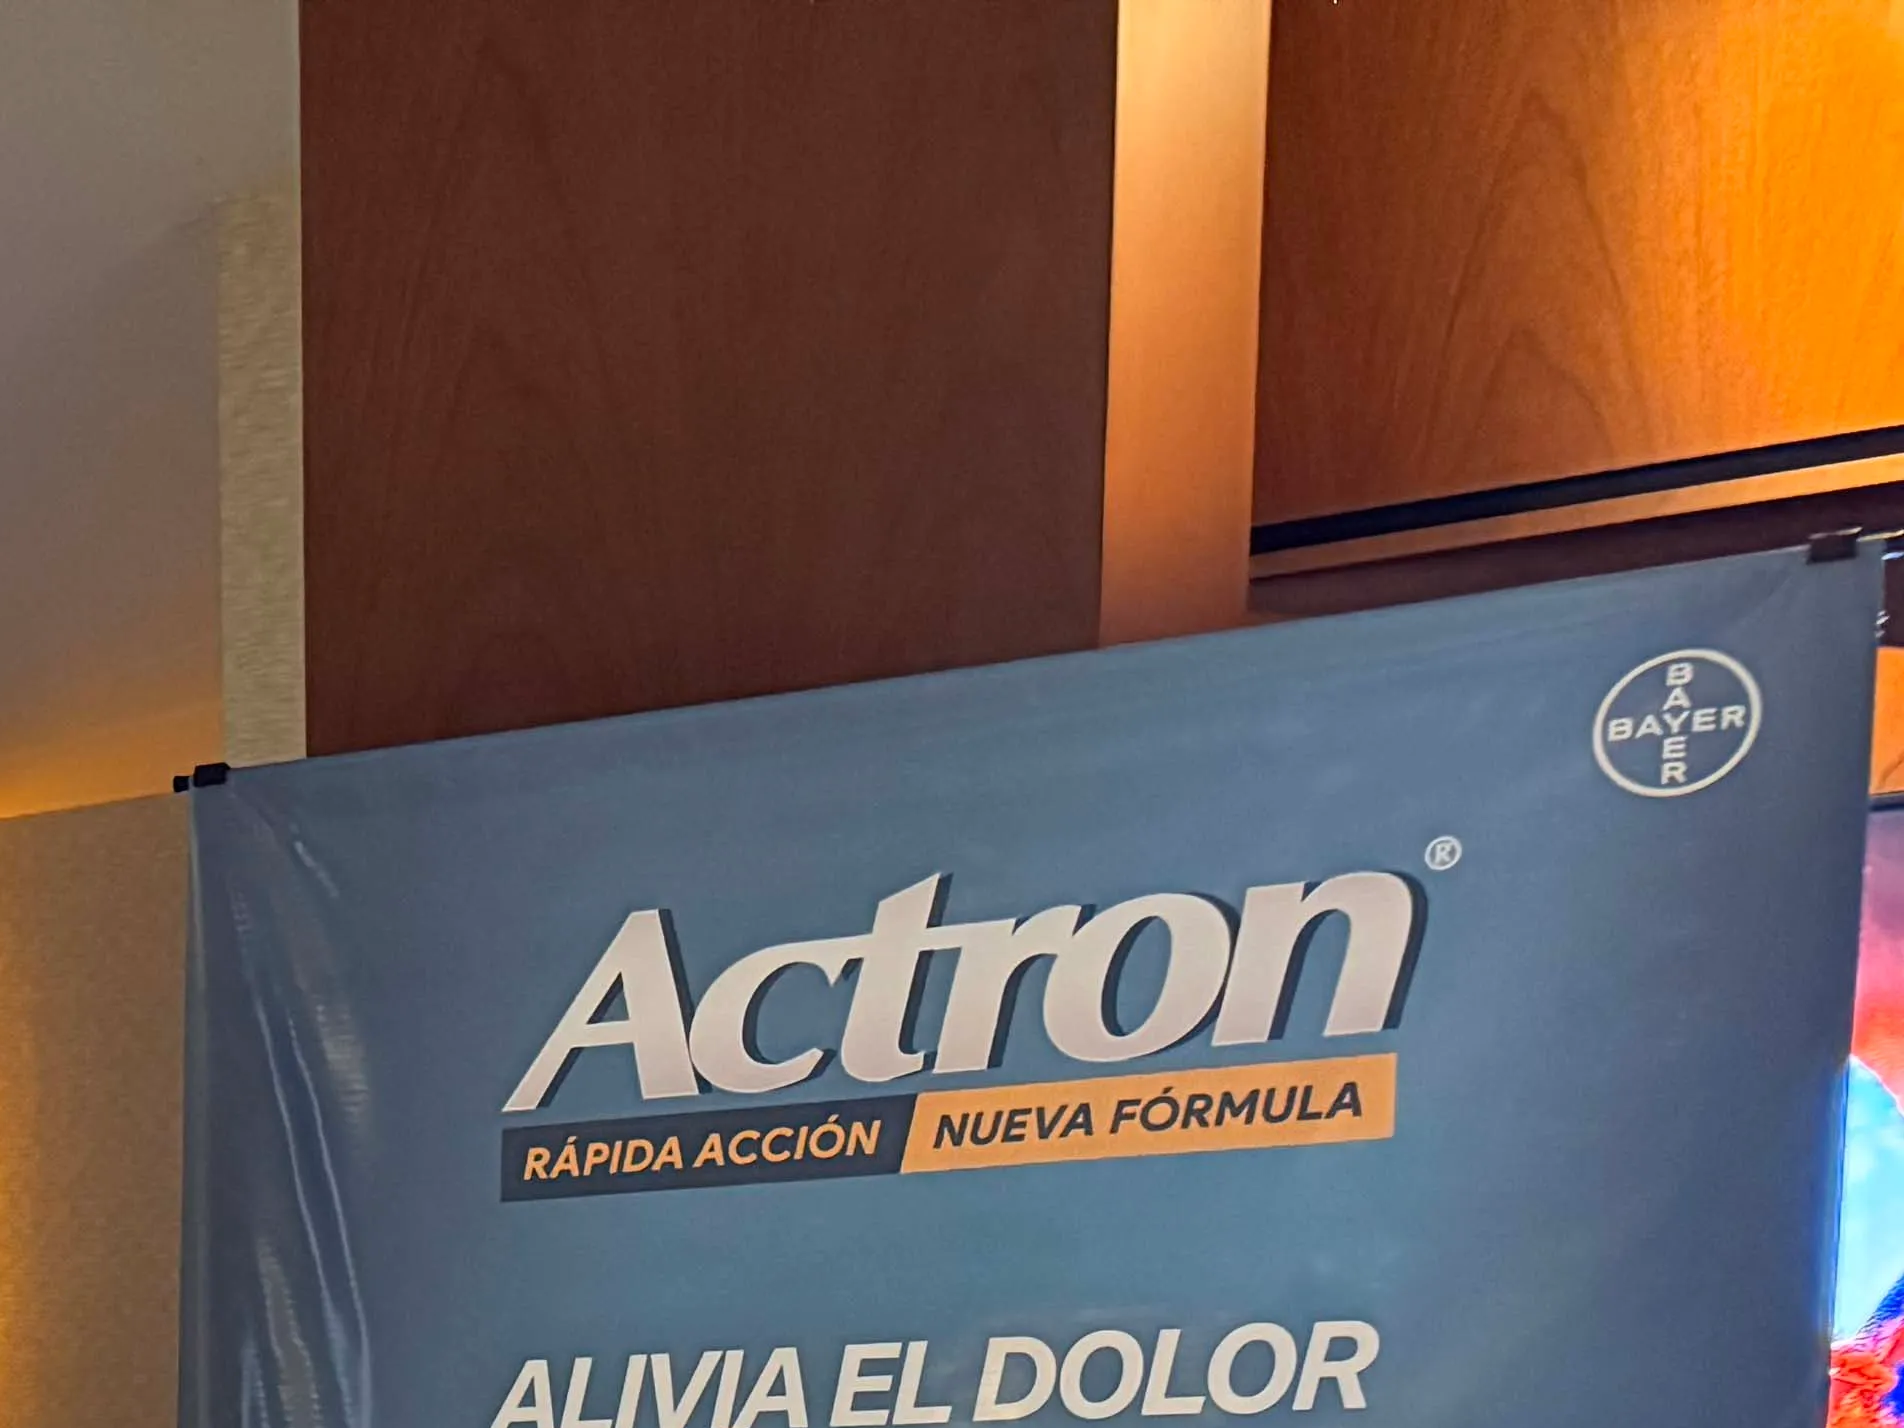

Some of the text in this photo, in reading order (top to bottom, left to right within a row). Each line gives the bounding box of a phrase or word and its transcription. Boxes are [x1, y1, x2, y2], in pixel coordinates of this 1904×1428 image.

[1607, 705, 1746, 742] BAYER
[1661, 662, 1694, 785] BAYER
[524, 1113, 880, 1181] RÁPIDA ACCIÓN
[932, 1080, 1364, 1151] NUEVA FÓRMULA
[829, 1340, 953, 1428] EL
[972, 1320, 1381, 1422] DOLOR
